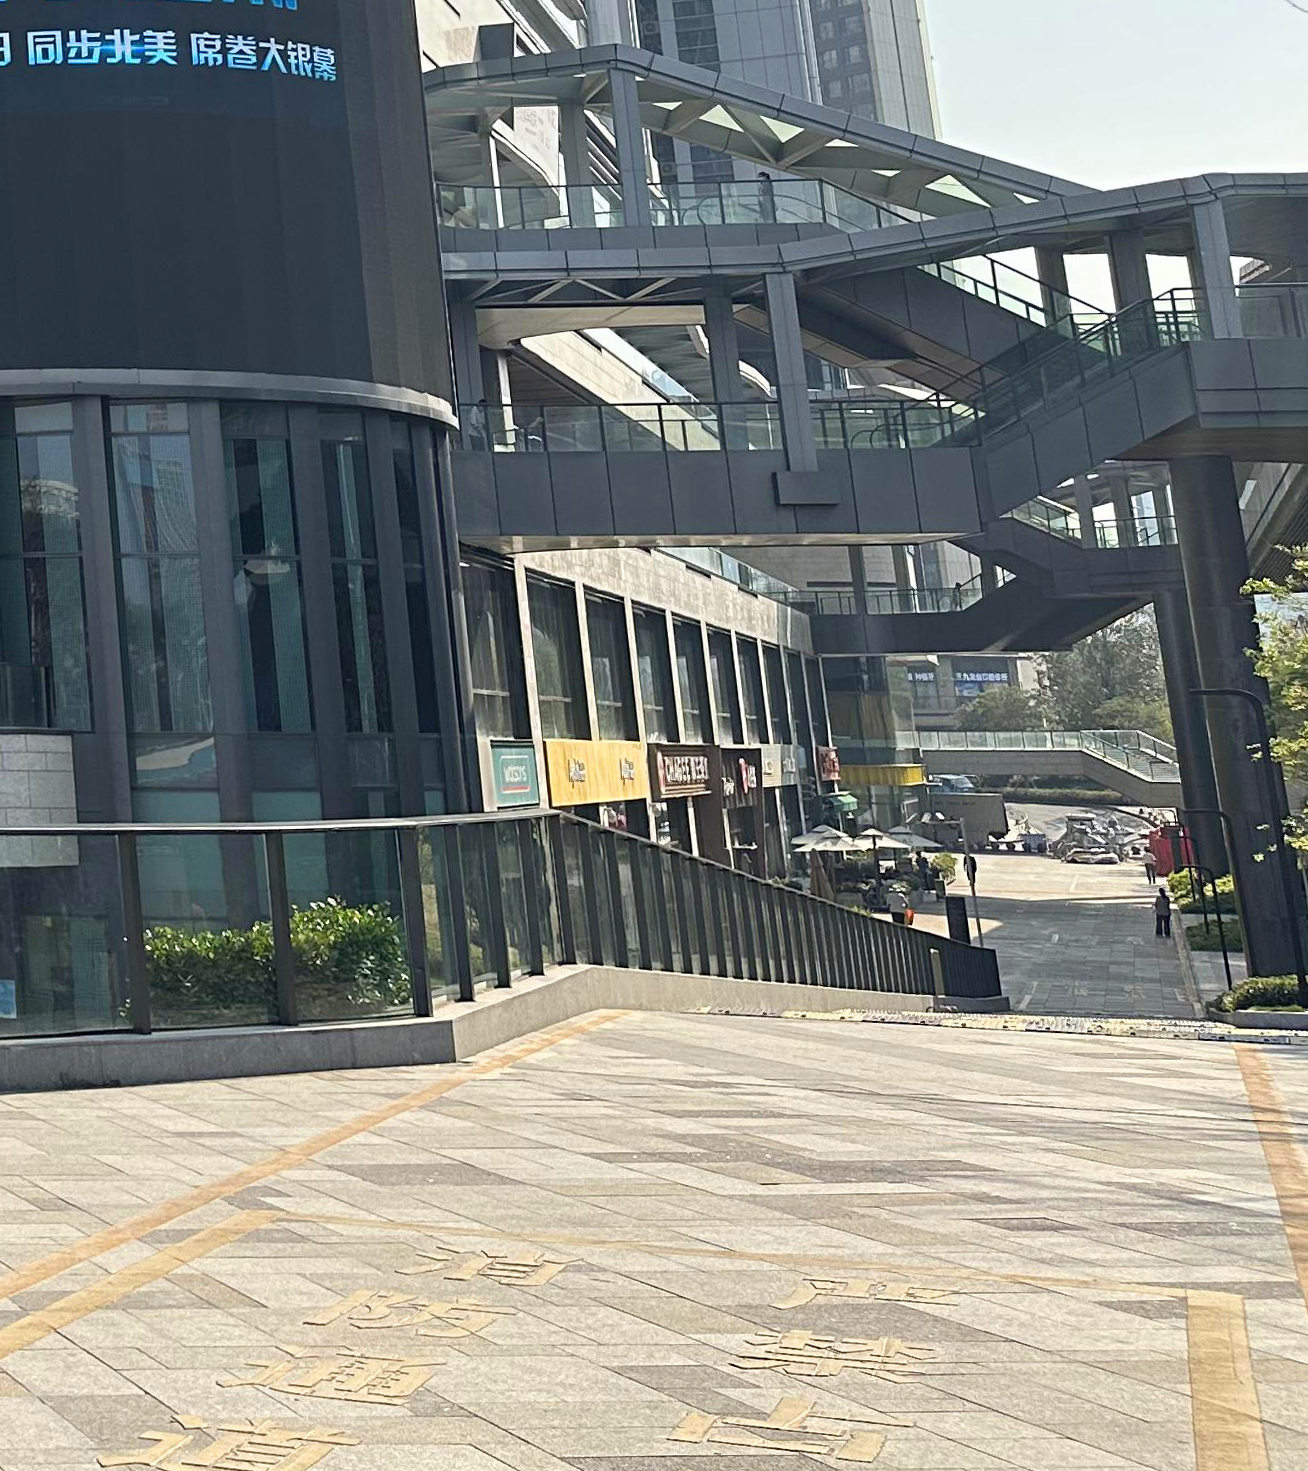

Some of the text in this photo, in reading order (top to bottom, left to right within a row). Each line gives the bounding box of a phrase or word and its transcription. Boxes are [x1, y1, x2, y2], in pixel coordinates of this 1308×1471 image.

[27, 29, 178, 66] 同步北美
[191, 33, 337, 82] 席卷大银幕
